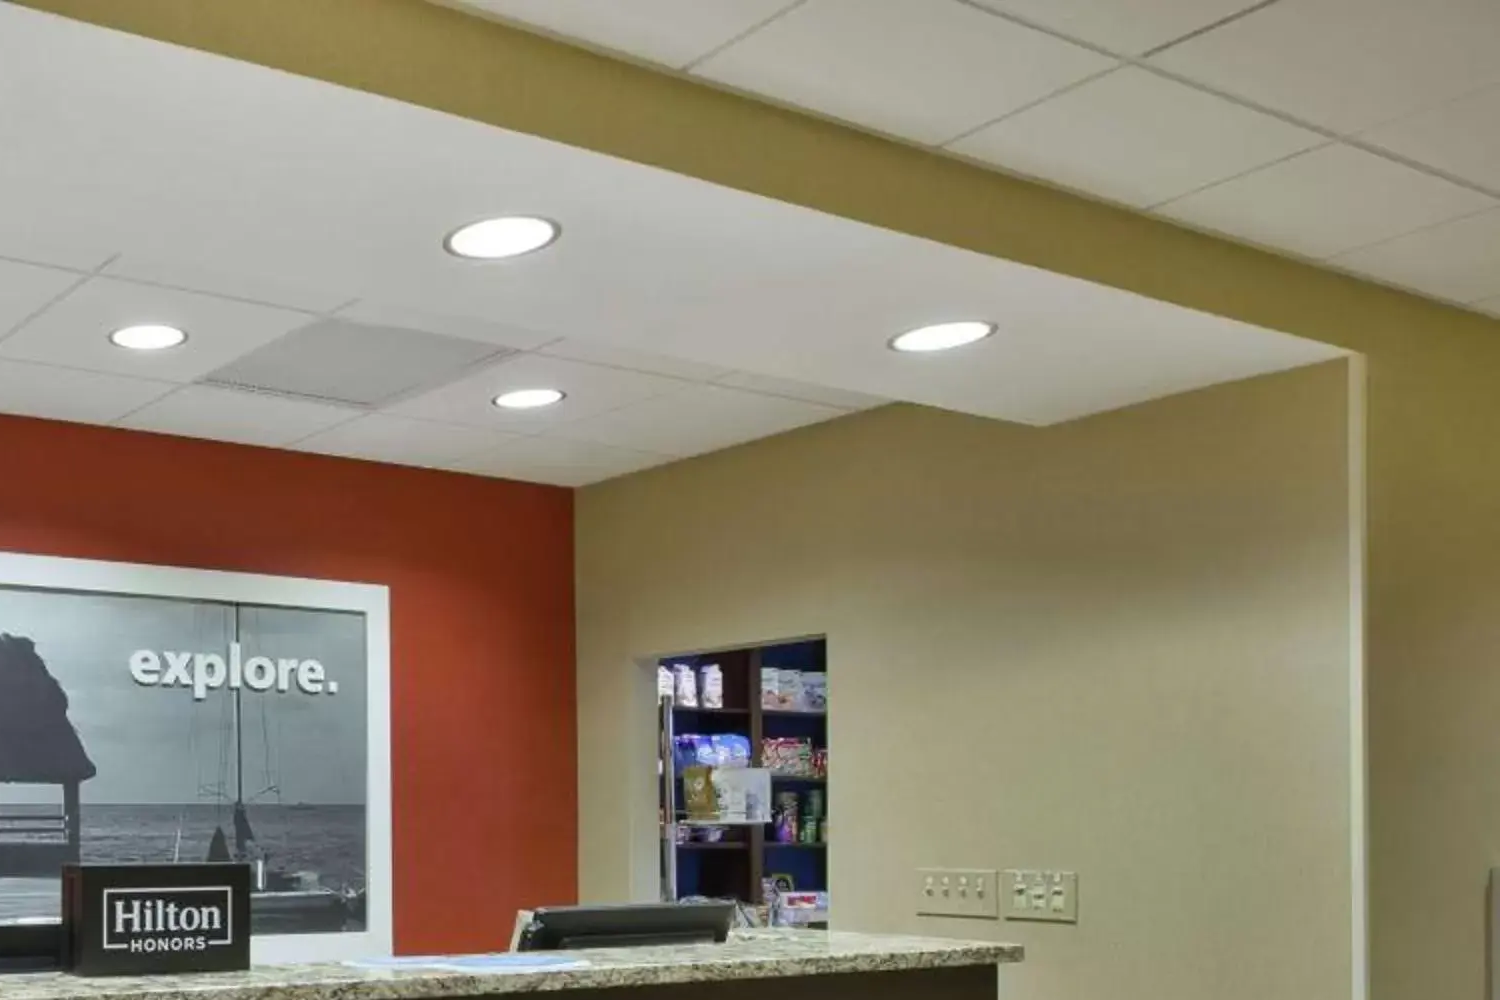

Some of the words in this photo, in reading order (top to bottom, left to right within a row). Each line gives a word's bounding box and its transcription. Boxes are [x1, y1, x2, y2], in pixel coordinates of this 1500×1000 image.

[128, 640, 339, 701] explore.
[113, 899, 222, 934] Hilton
[130, 936, 207, 953] HONORS
